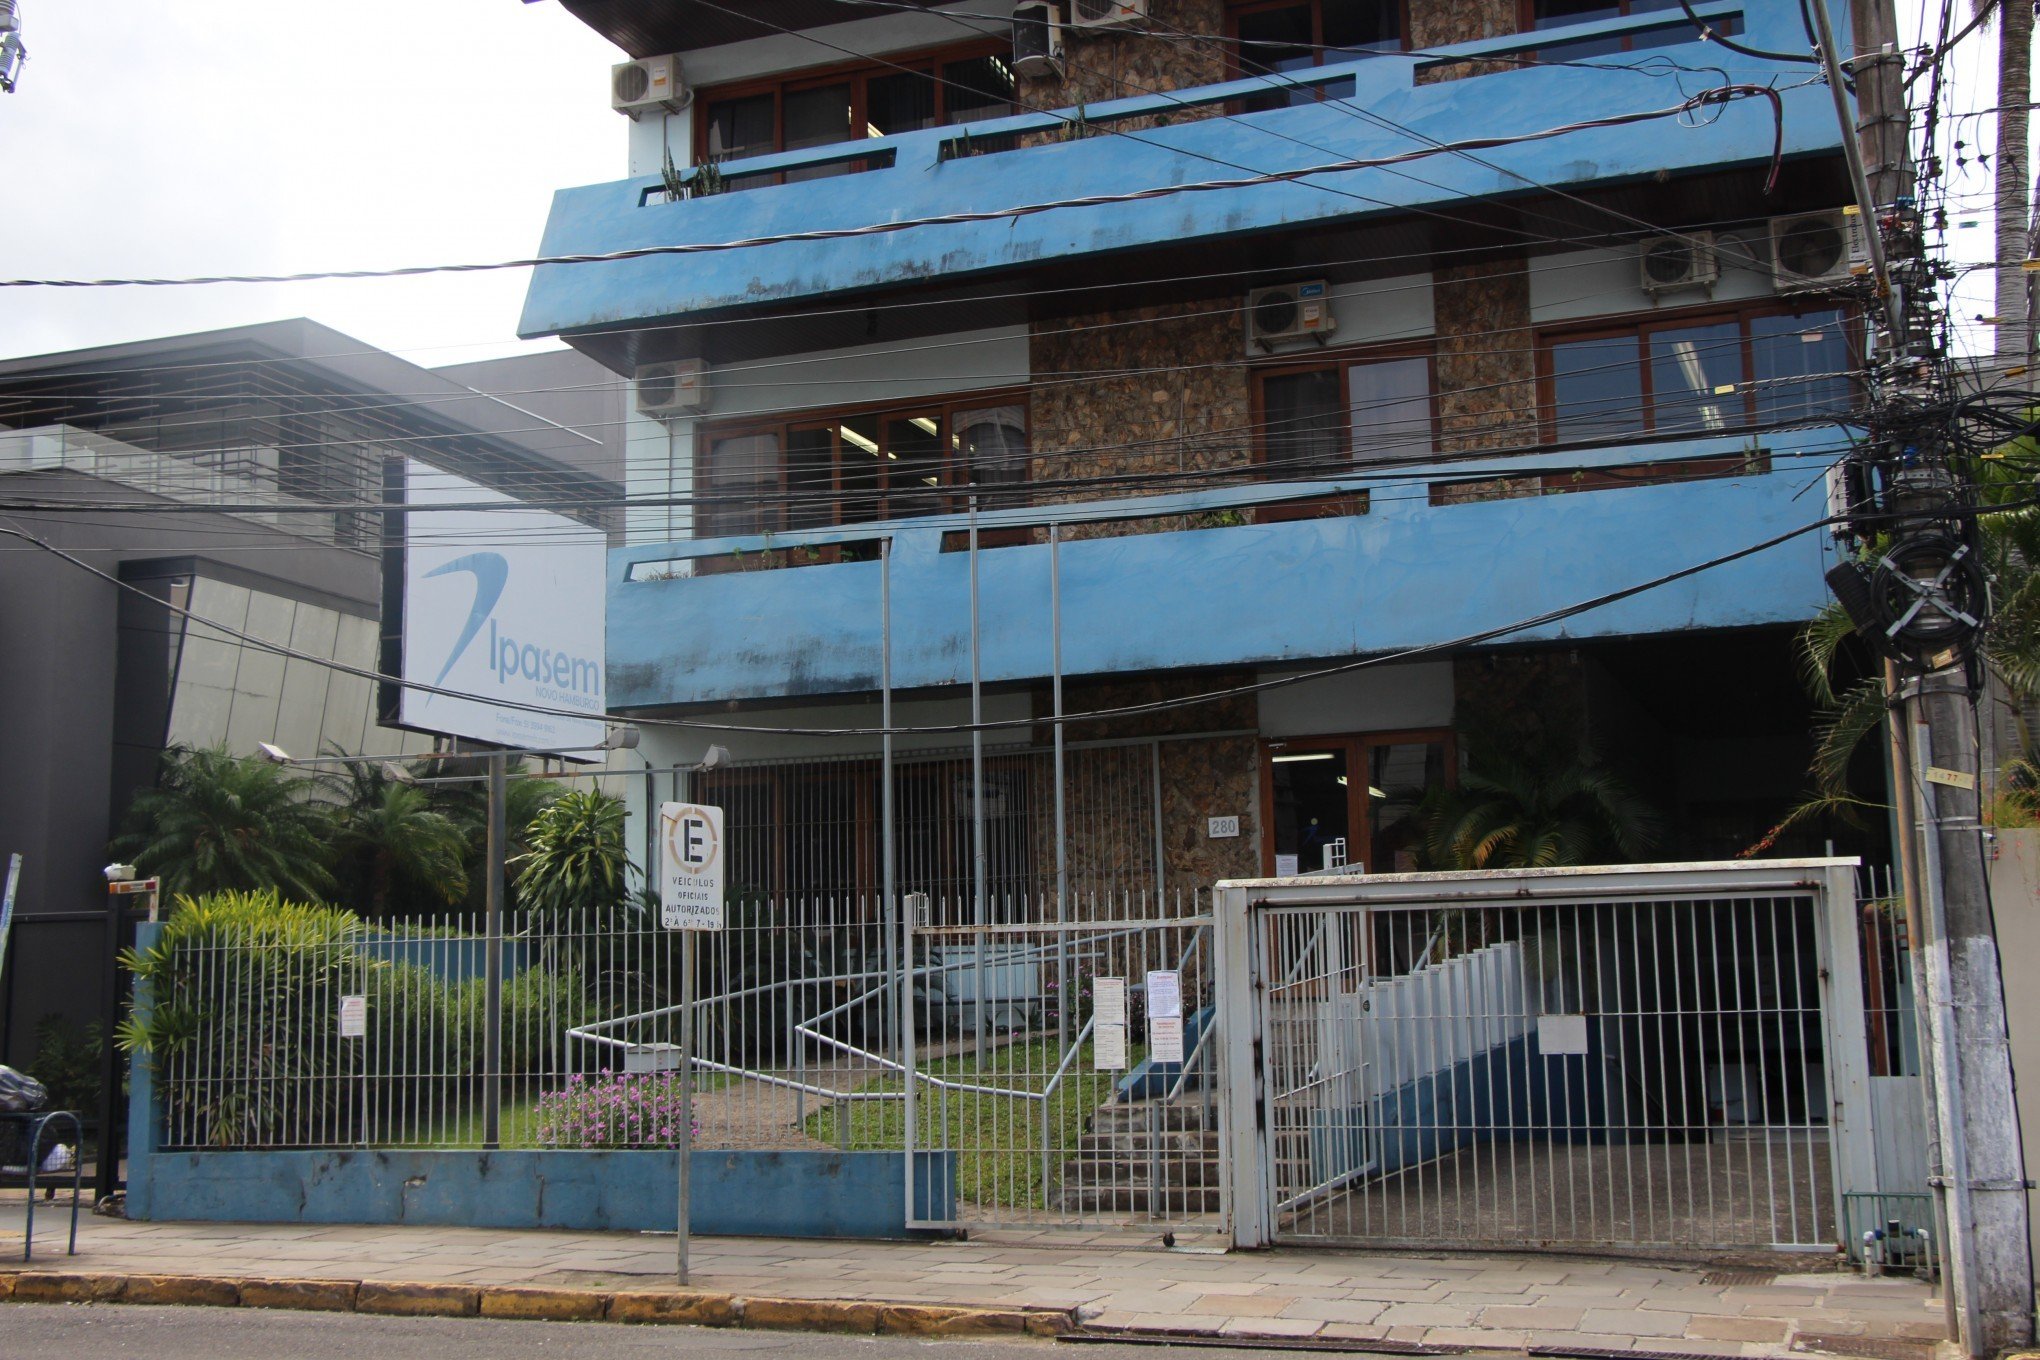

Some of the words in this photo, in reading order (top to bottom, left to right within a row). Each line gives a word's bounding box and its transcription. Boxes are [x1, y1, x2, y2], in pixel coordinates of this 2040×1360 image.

[490, 618, 599, 696] Ipasem
[536, 686, 558, 701] NOVO
[560, 693, 599, 711] HAMBURGO
[1212, 820, 1235, 834] 280
[684, 819, 703, 862] E
[678, 892, 708, 901] OFICIAIS
[665, 905, 720, 916] AUTORIZADOS
[707, 920, 715, 929] 19
